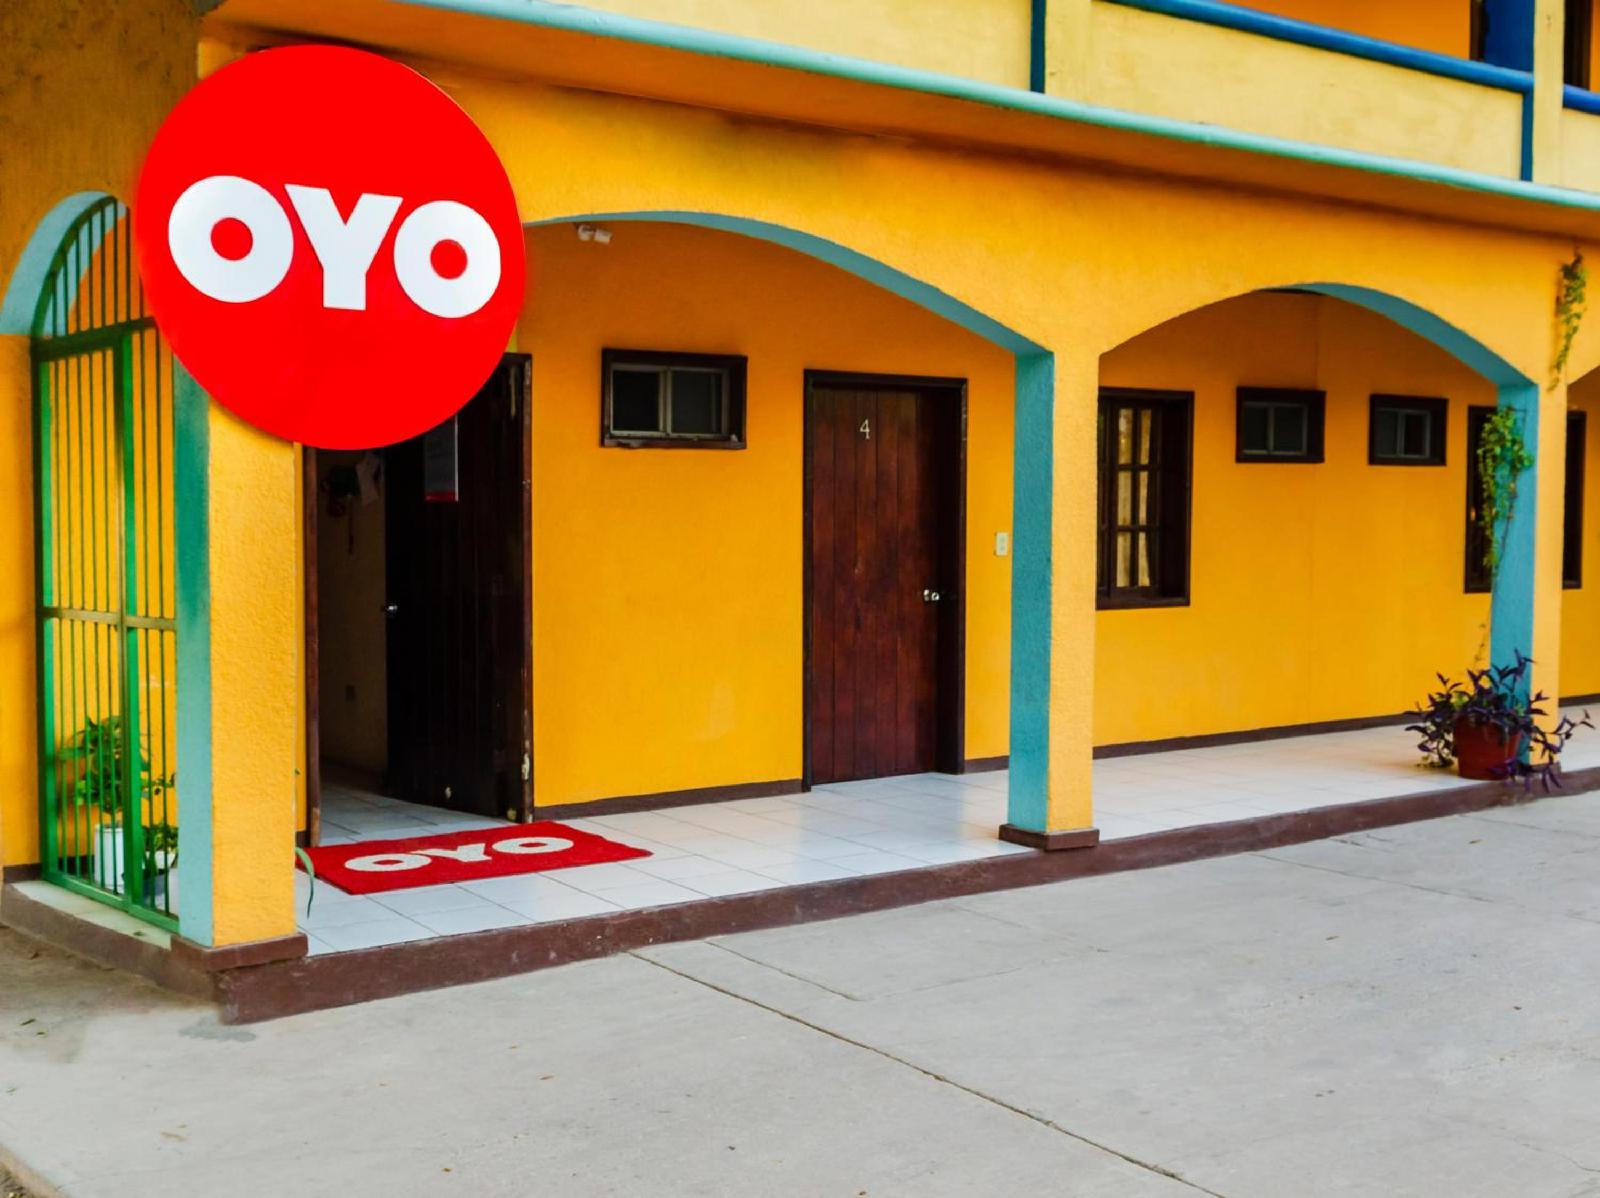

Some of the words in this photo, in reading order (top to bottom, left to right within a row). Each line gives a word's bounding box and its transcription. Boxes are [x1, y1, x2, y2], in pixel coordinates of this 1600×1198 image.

[168, 175, 502, 319] OYO
[859, 419, 871, 440] 4
[344, 836, 574, 872] OYO
